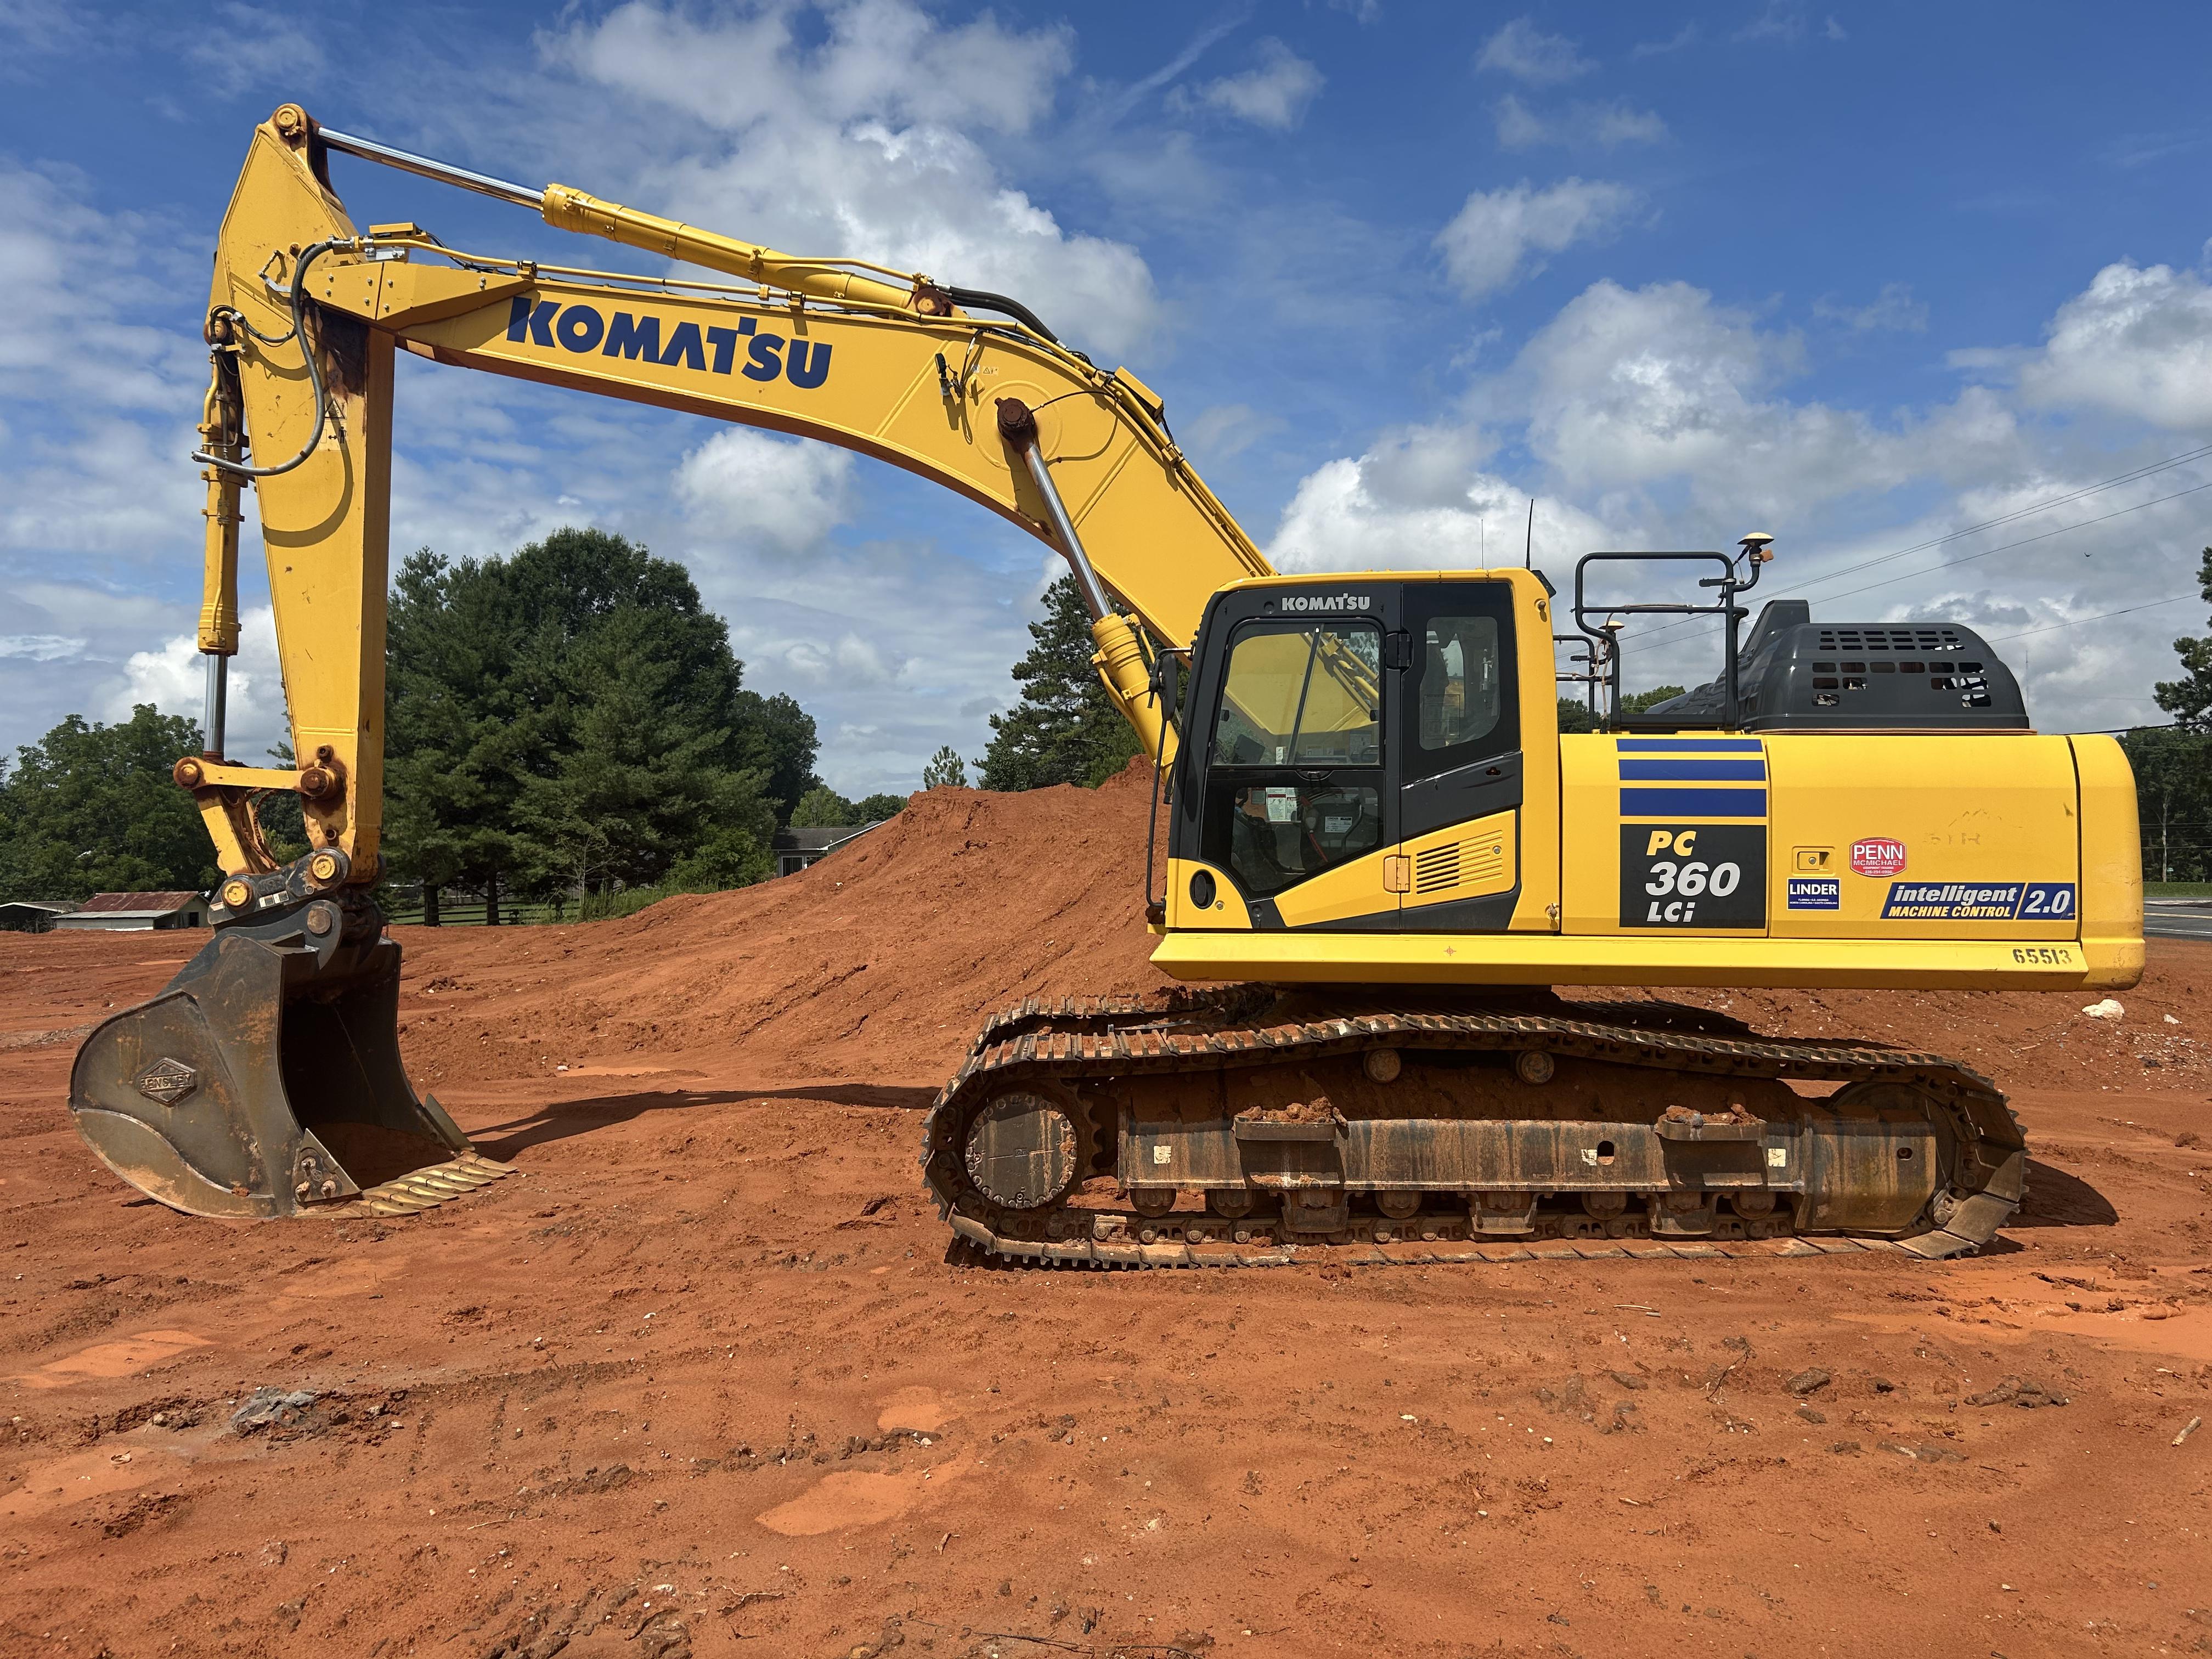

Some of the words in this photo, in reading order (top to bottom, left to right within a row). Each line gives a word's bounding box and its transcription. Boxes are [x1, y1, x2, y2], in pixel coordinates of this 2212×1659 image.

[507, 296, 832, 388] KOMATSU
[1282, 593, 1370, 611] KOMATSU
[1646, 831, 1696, 856] PC
[1854, 845, 1903, 860] PENN
[1646, 862, 1740, 896] 360
[1790, 884, 1837, 895] LINDER
[1894, 885, 2017, 905] intelligent
[1647, 901, 1695, 922] LCi
[1888, 906, 1949, 917] MACHINE
[1952, 906, 2011, 917] CONTROL
[2024, 890, 2070, 913] 2.0
[2012, 949, 2072, 964] 65513
